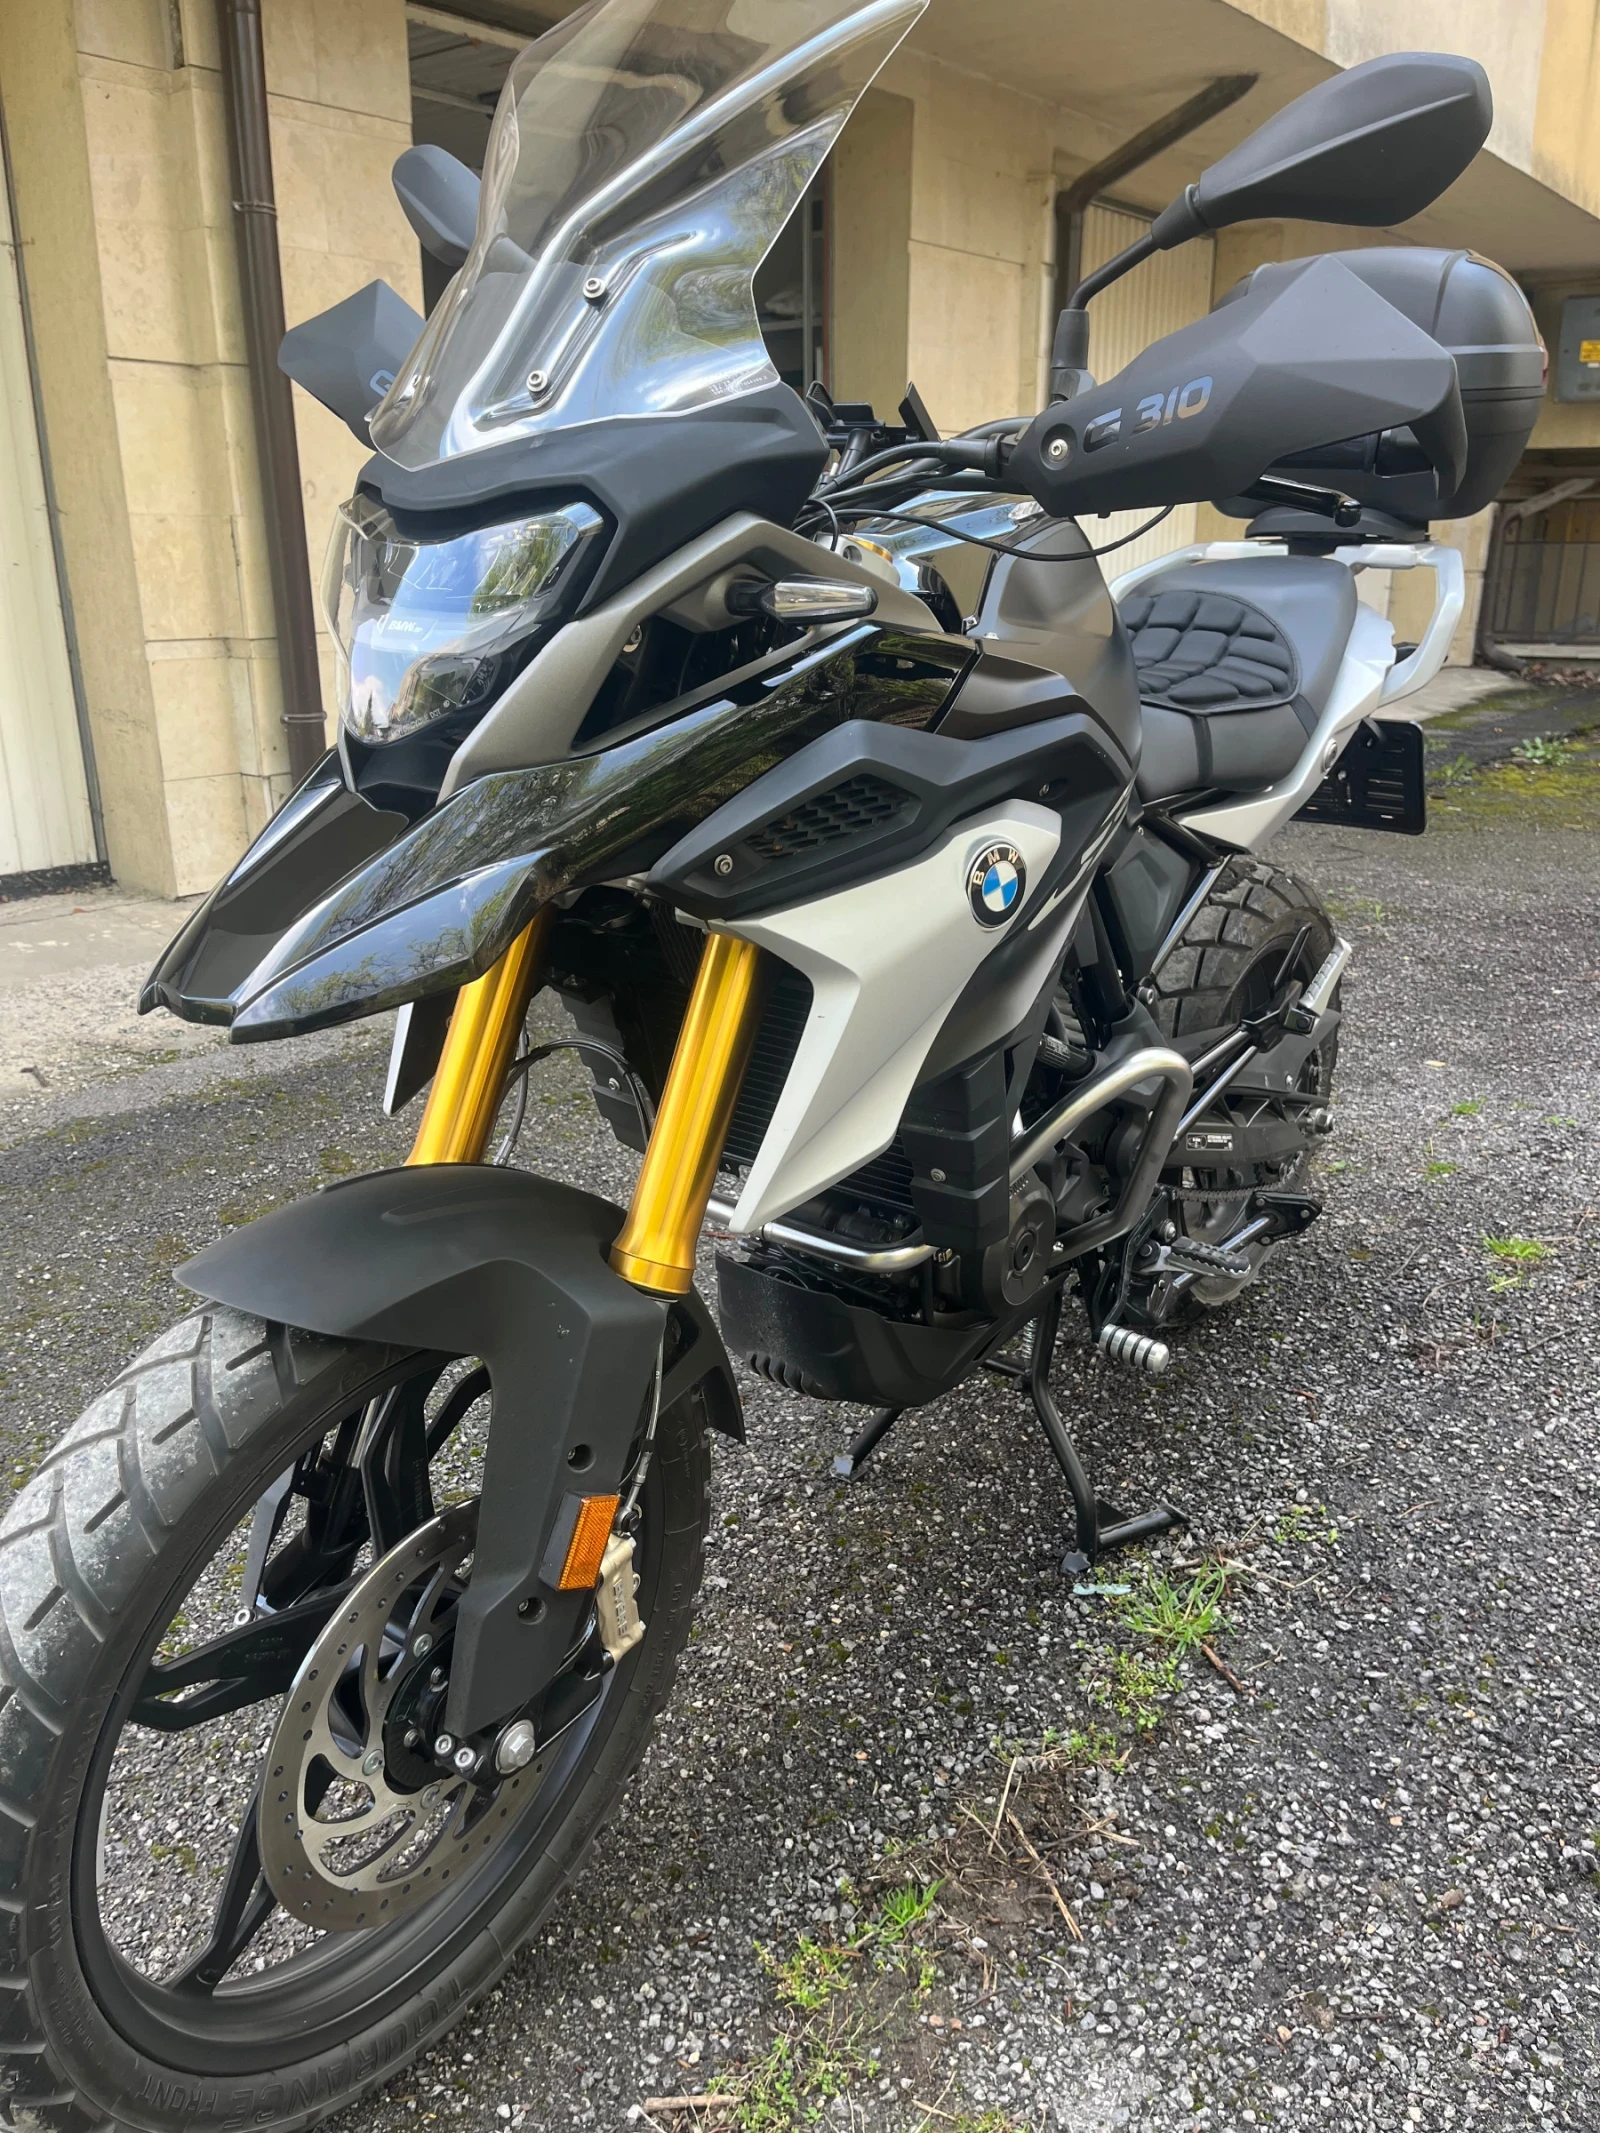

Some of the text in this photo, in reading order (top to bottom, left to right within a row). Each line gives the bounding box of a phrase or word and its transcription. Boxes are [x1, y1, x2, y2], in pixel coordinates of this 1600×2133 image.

[1082, 375, 1214, 454] G 310
[429, 708, 441, 719] DOT
[972, 847, 1020, 886] BMW
[613, 1578, 629, 1637] BYBRE
[135, 1976, 469, 2130] TOURANCE FRONT
